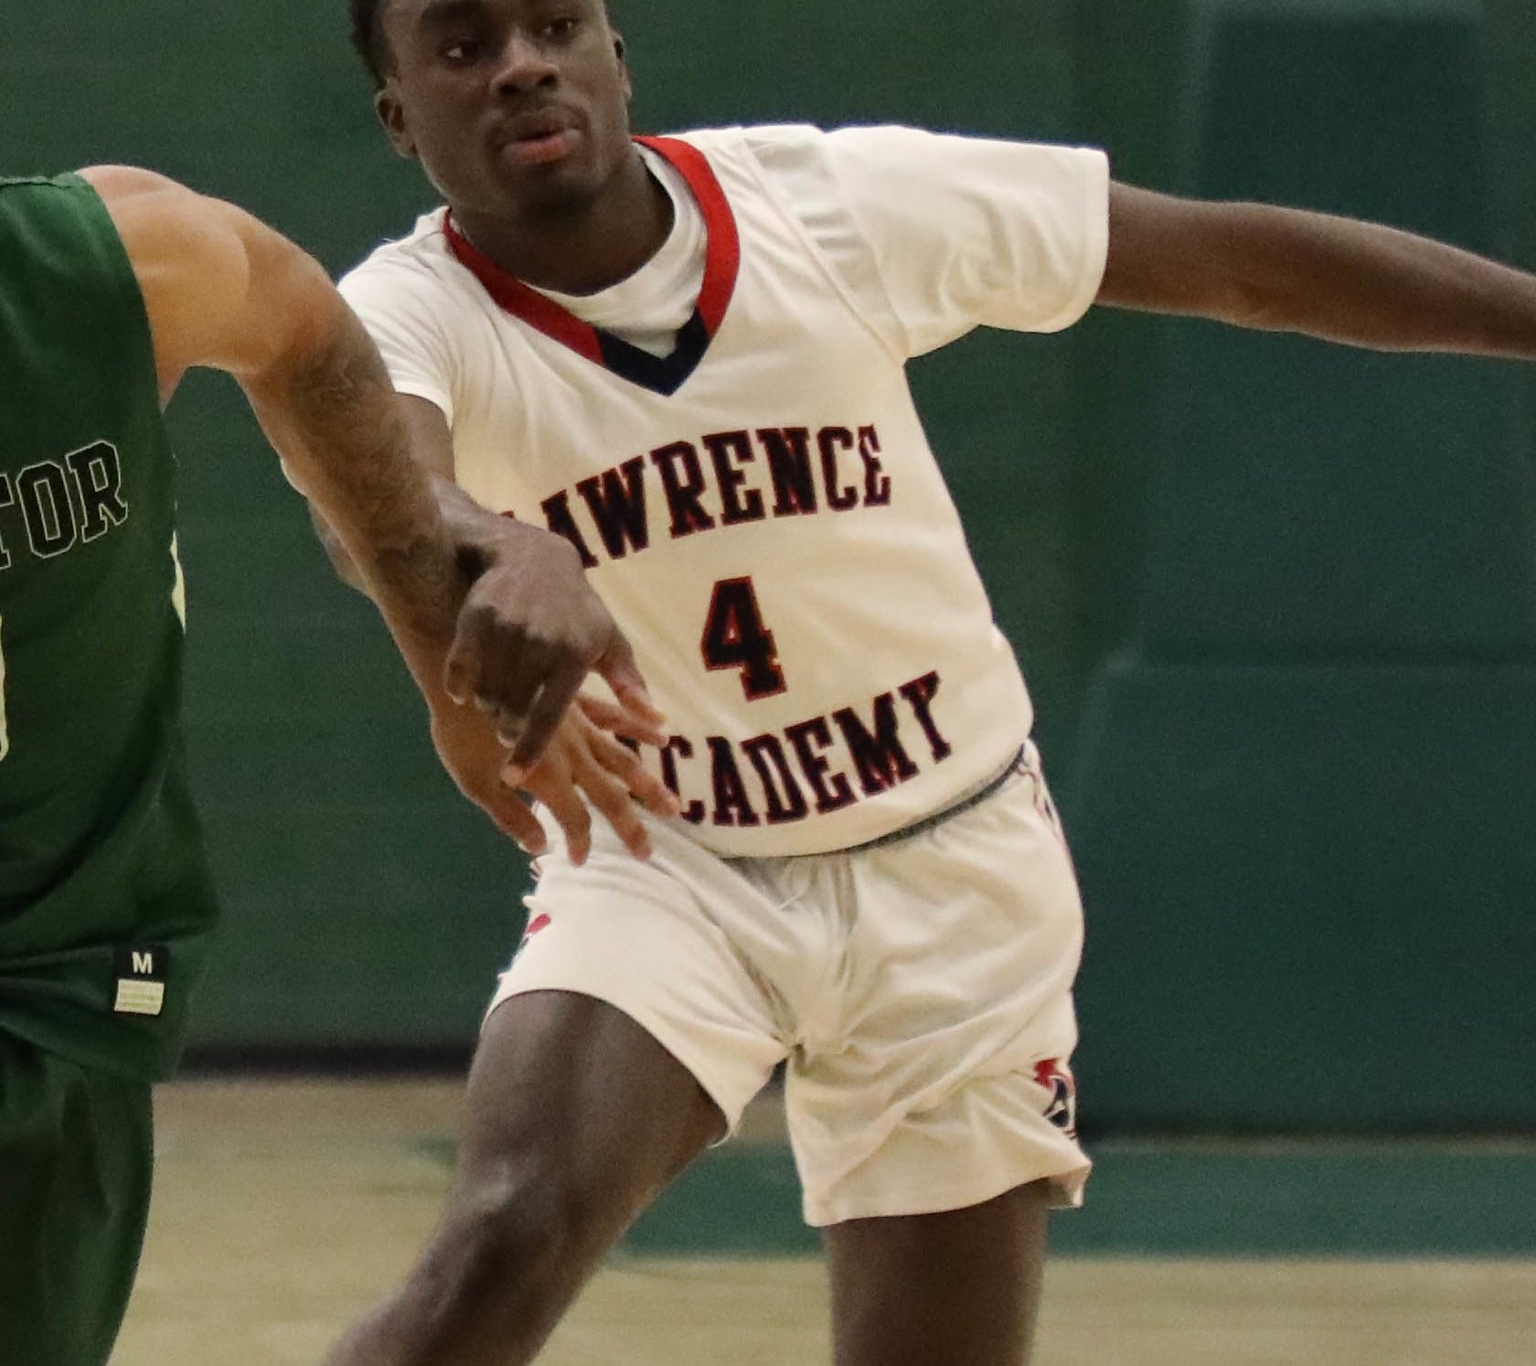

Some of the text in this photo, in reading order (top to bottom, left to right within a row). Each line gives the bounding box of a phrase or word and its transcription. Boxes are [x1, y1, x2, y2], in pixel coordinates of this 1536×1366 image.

[500, 423, 892, 570] AWRENCE
[701, 575, 788, 703] 4
[615, 669, 954, 829] CADEMY
[131, 951, 154, 975] M
